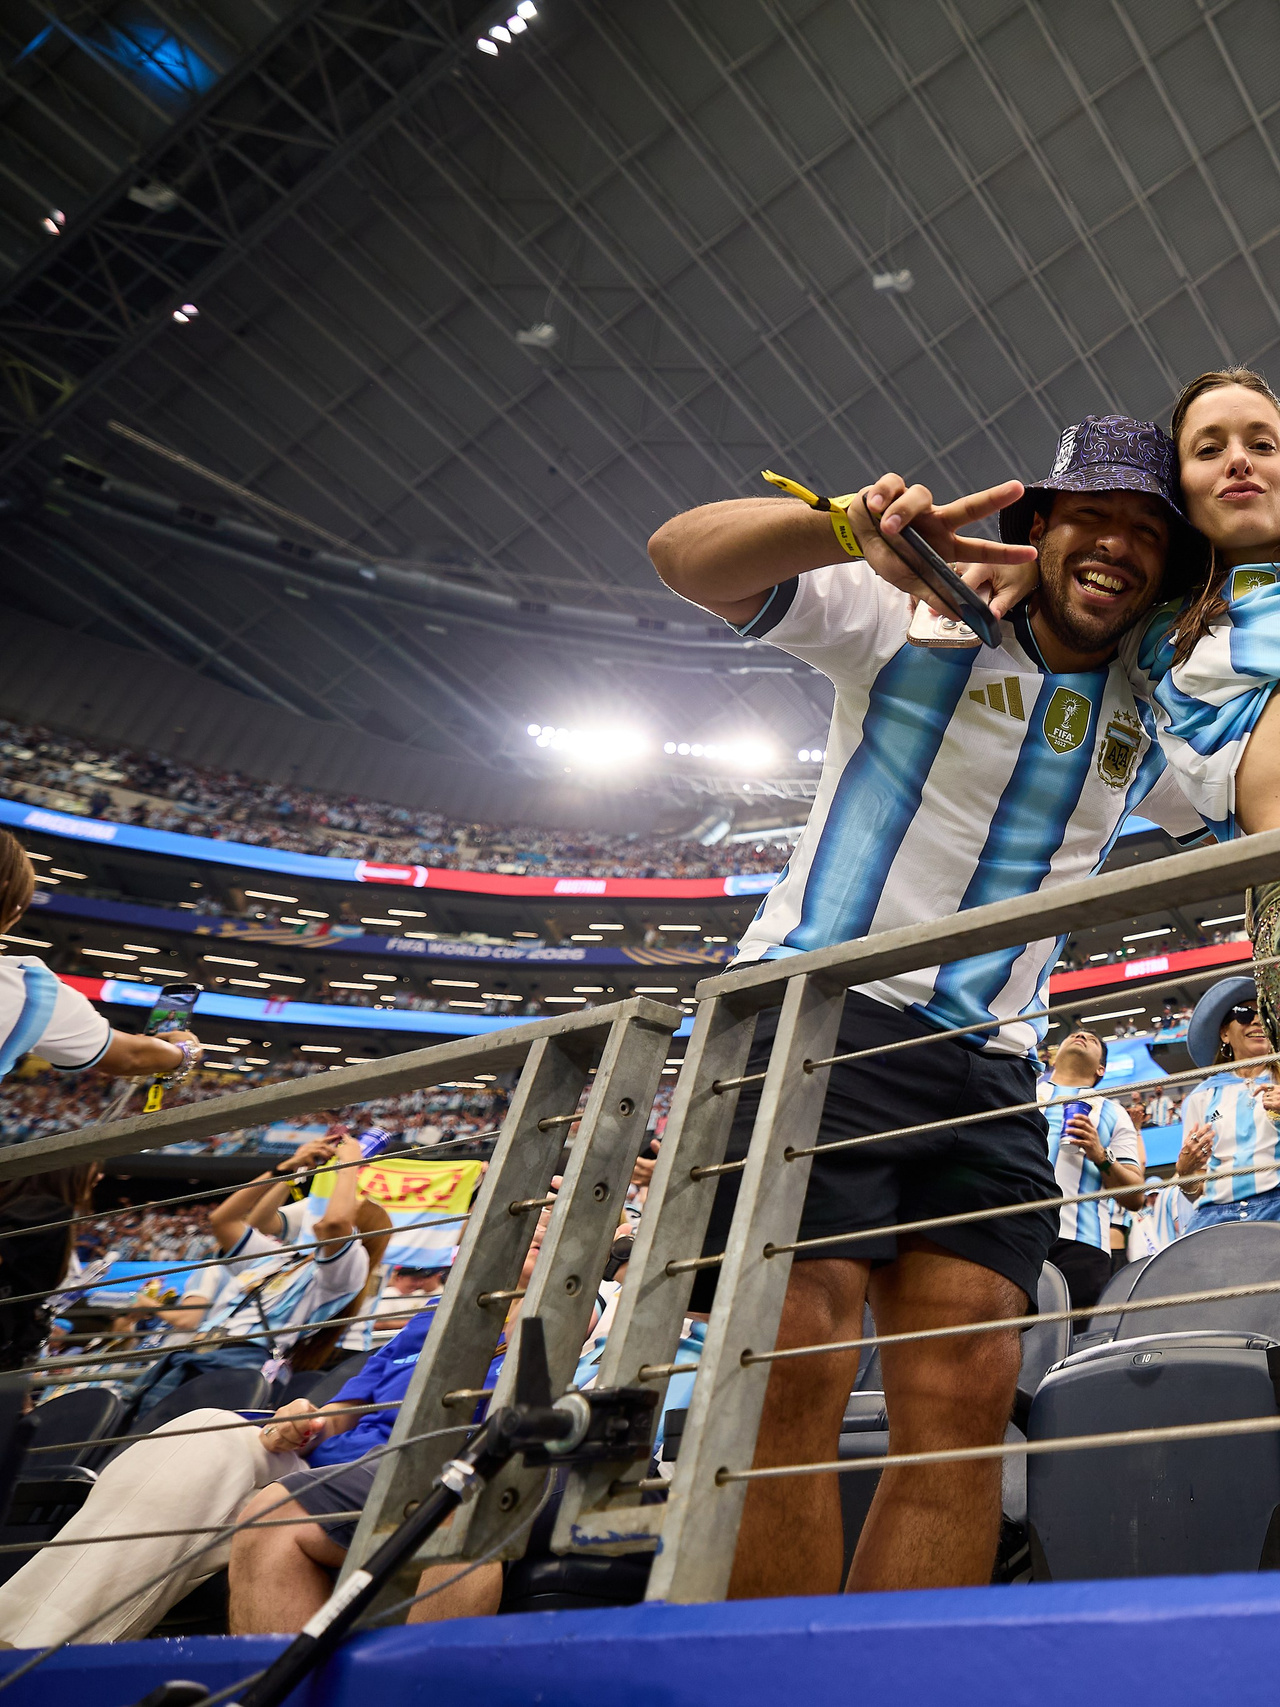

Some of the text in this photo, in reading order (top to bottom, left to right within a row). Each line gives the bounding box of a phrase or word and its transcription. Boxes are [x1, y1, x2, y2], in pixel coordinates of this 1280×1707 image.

[1053, 727, 1073, 742] FIFA
[1054, 740, 1067, 748] 2022
[386, 938, 427, 953] FIFA
[427, 942, 493, 958] WORLD
[526, 947, 586, 960] 2026
[1124, 957, 1169, 978] AUSTRIA
[1141, 1353, 1152, 1363] 10
